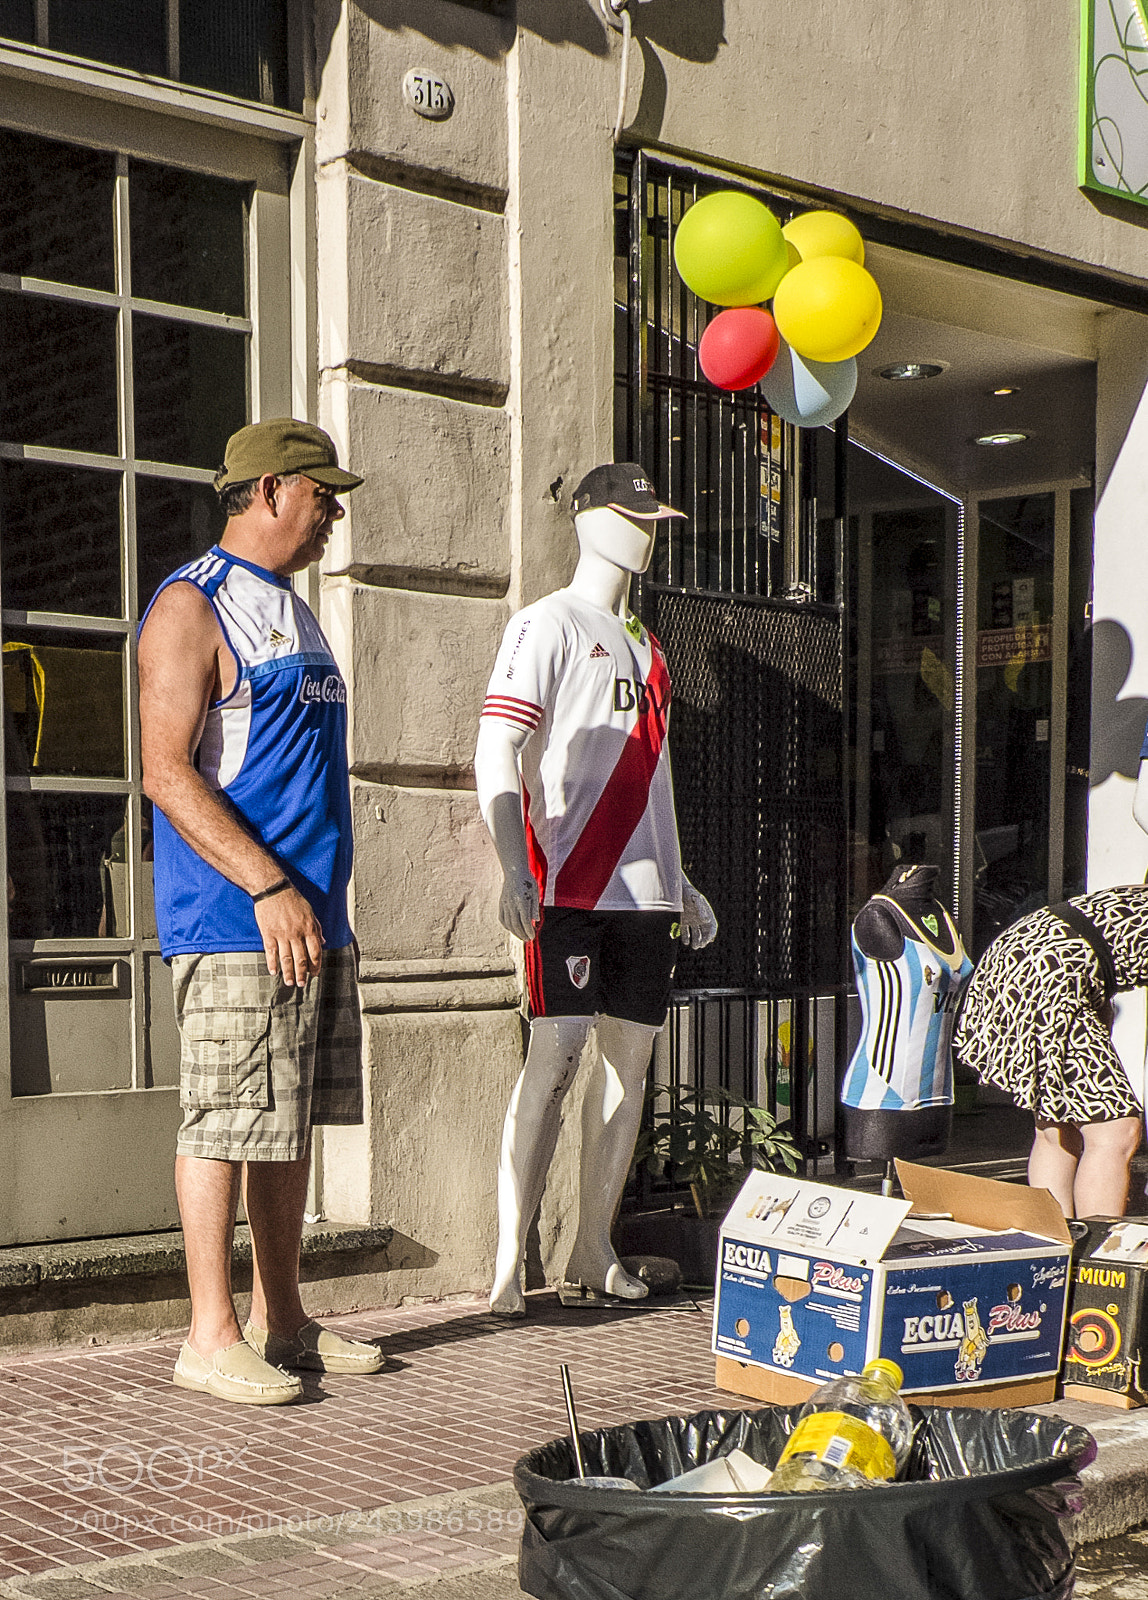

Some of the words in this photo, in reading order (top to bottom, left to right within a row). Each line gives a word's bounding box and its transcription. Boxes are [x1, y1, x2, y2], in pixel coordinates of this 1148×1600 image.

[413, 76, 445, 109] 313
[723, 1242, 772, 1273] ECUA
[811, 1262, 865, 1293] Plus
[902, 1312, 965, 1343] ECUA
[987, 1303, 1042, 1335] Plus
